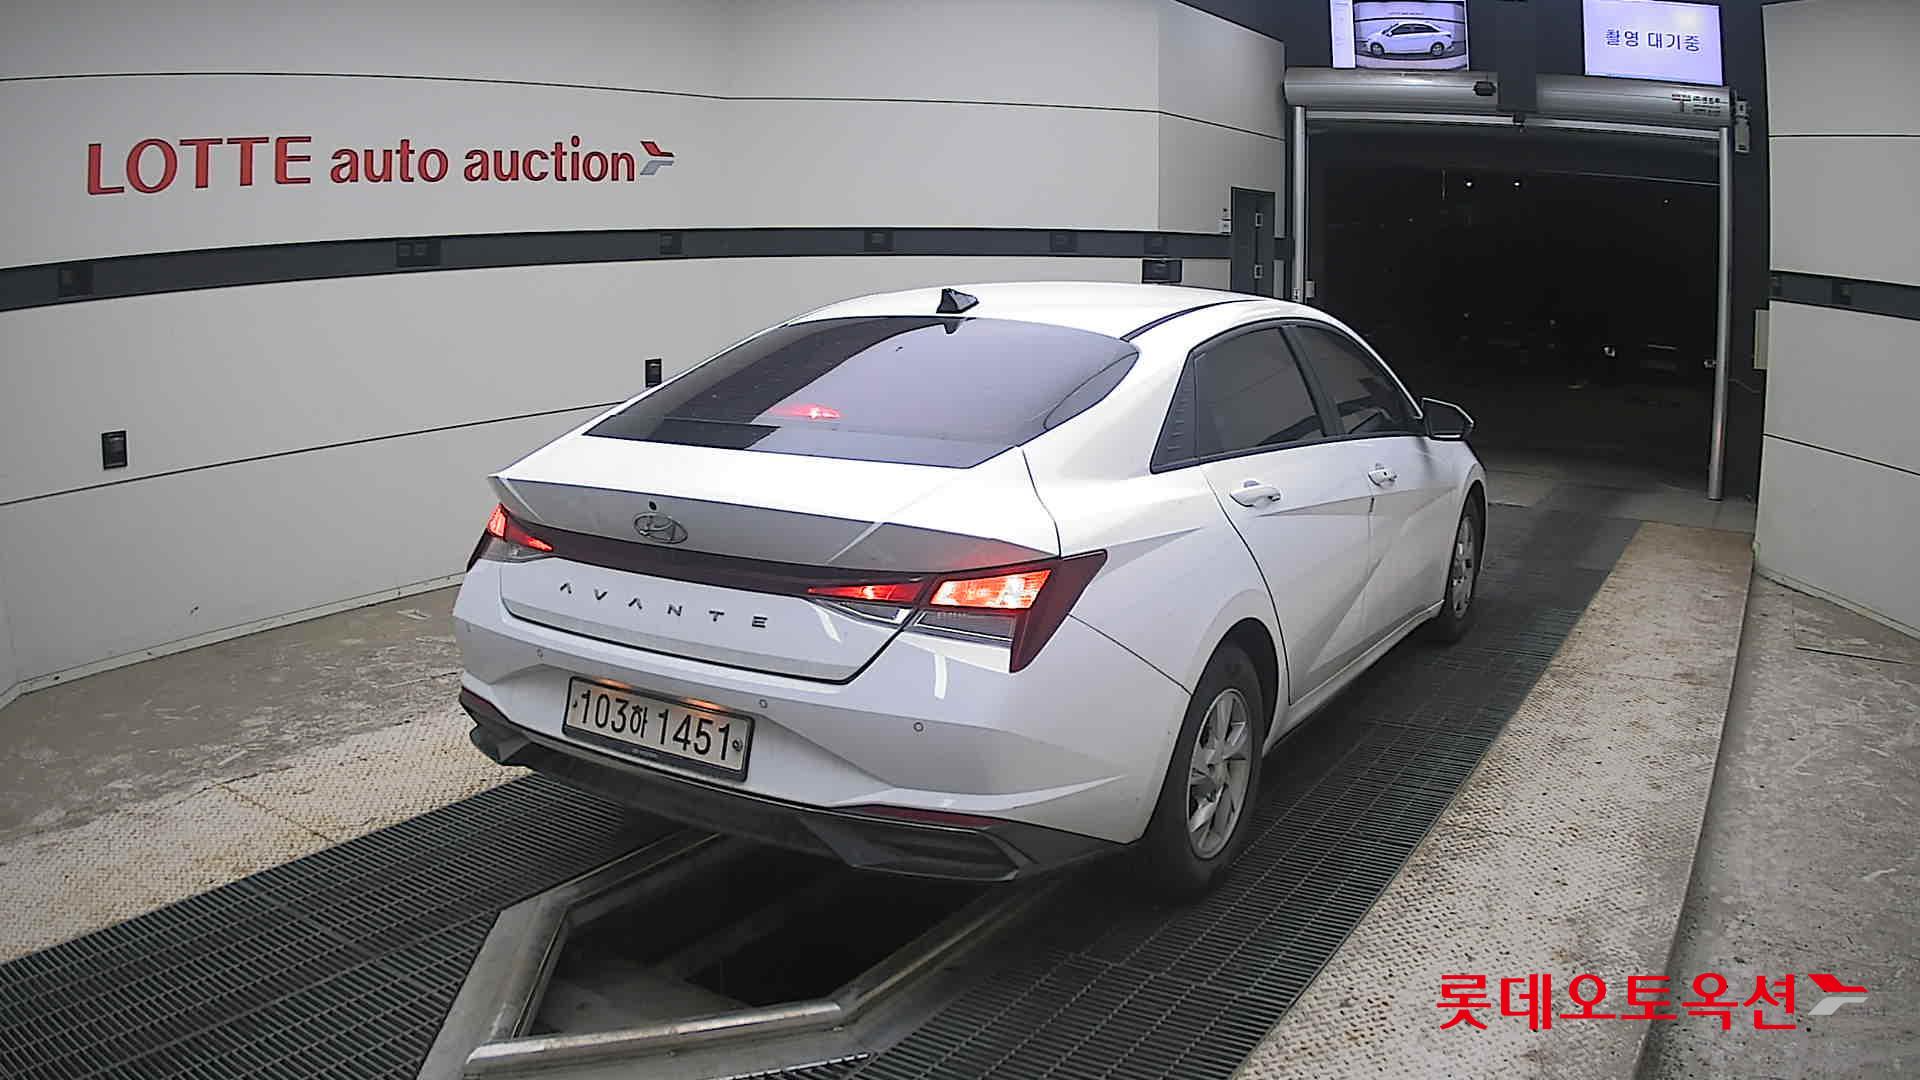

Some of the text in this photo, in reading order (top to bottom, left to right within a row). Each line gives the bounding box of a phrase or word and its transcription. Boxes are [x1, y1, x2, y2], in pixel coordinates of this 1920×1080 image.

[1647, 32, 1700, 52] 대기중
[87, 135, 635, 196] LOTTE auto auction
[560, 582, 768, 628] AVANTE
[581, 689, 731, 761] 103하 1451
